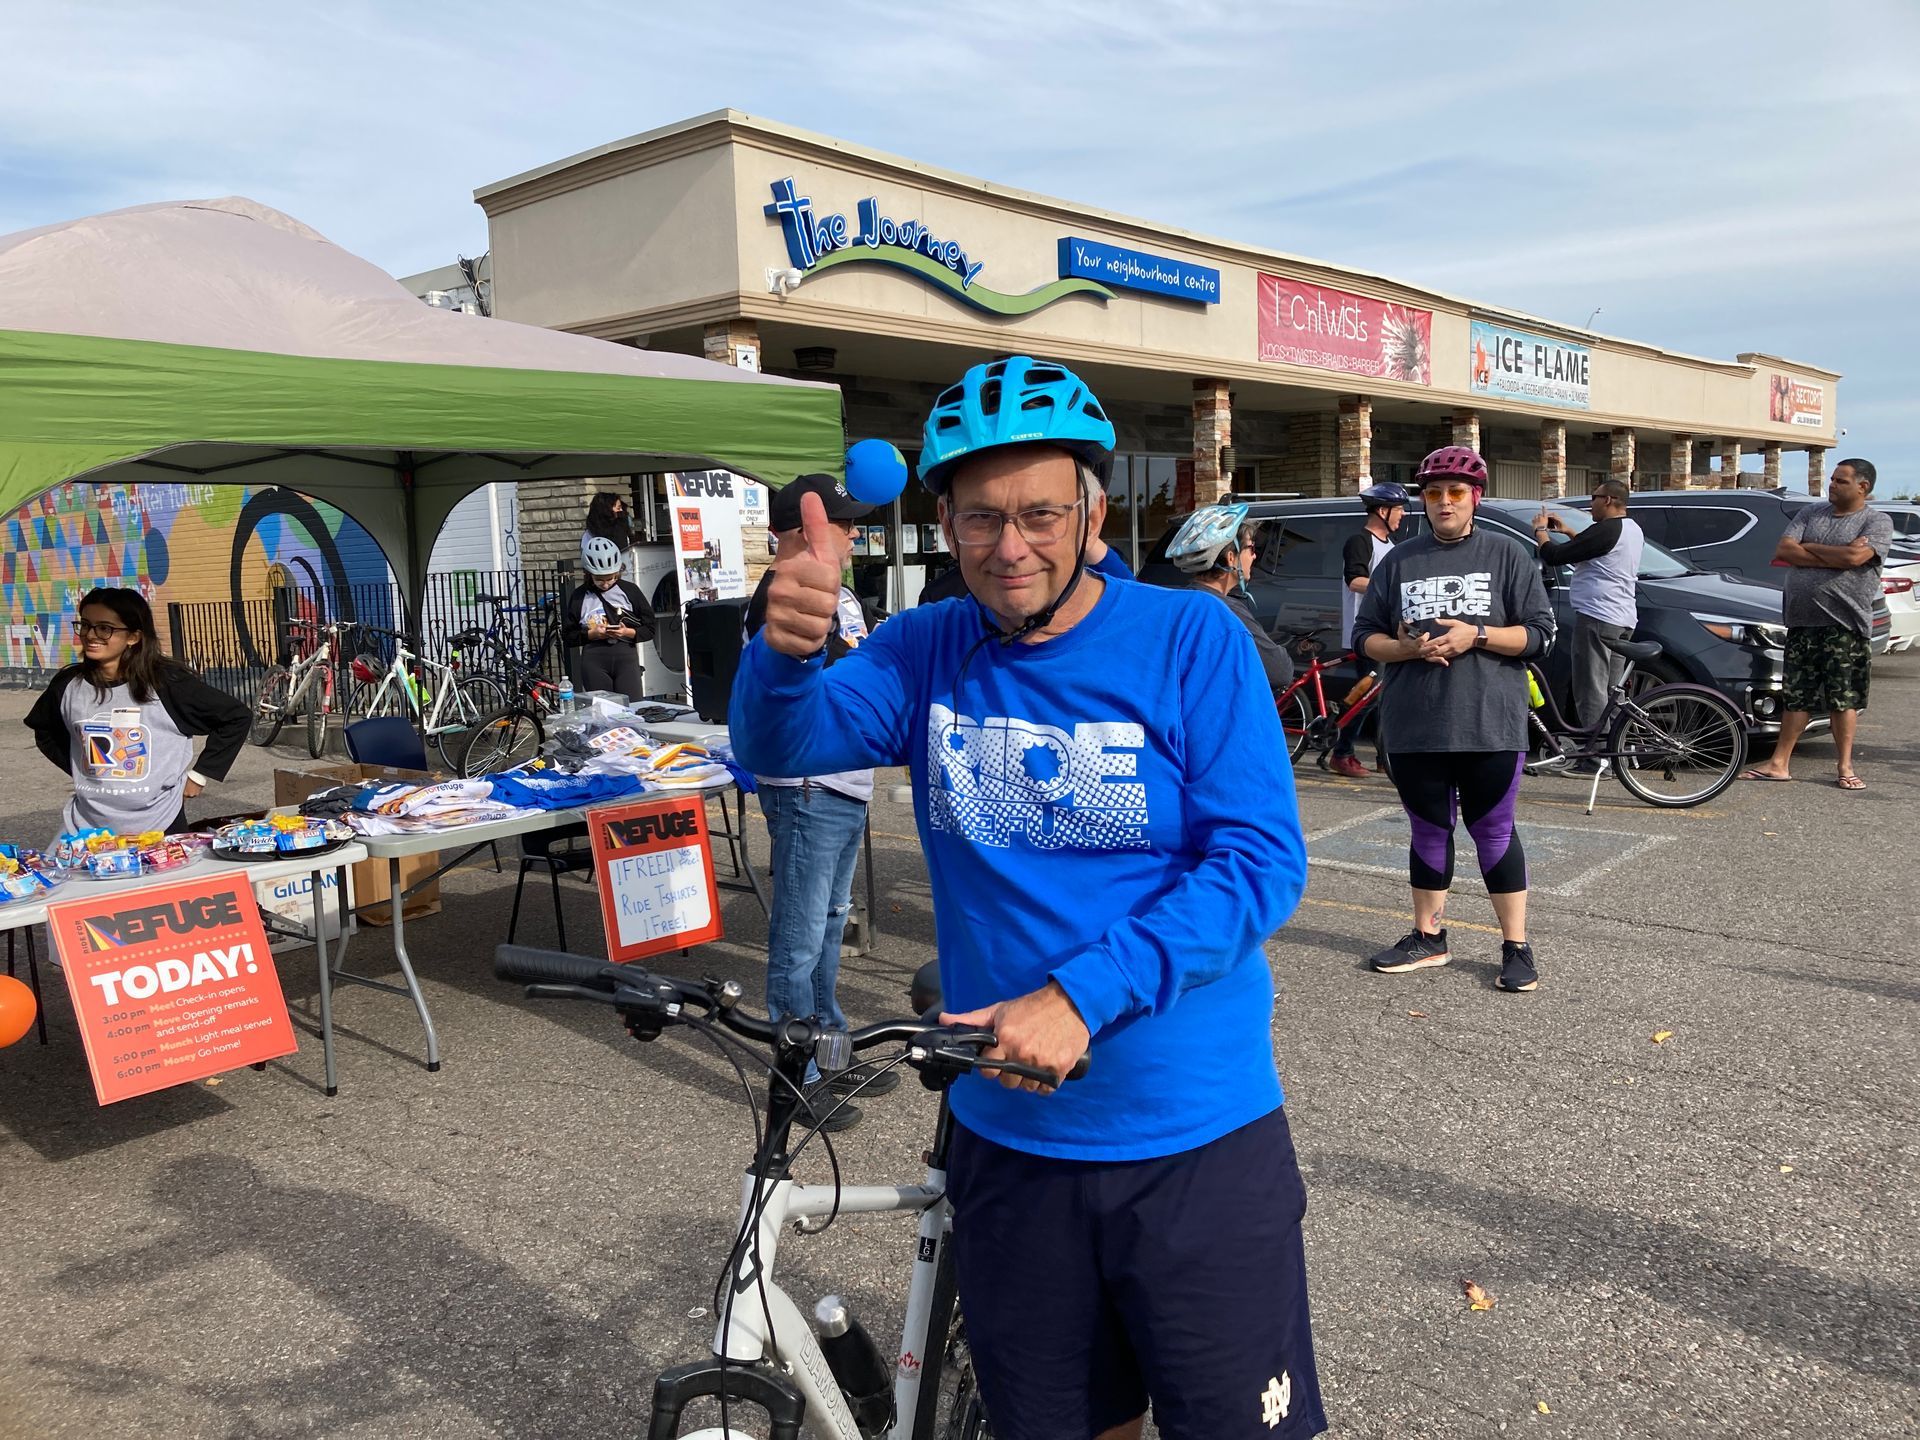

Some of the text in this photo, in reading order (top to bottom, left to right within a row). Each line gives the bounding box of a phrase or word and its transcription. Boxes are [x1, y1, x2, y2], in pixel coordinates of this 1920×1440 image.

[864, 195, 983, 290] Journey
[1076, 246, 1216, 293] Your neighbourhood centre
[1476, 370, 1489, 384] ICE
[1496, 335, 1589, 386] ICE FLAME
[1400, 572, 1491, 609] RIDE
[1407, 598, 1491, 622] REFUGE
[607, 809, 698, 849] REFUGE
[84, 891, 243, 952] REFUGE
[622, 894, 651, 916] RIDE
[90, 943, 258, 1006] TODAY!
[102, 985, 246, 1024] 3:00 pm Meet Check-in opens
[107, 997, 259, 1039] 4:00 pm Move Opening remarks
[113, 1016, 273, 1065] 5:00 pm Munch Light meal served
[156, 1015, 217, 1038] and send-off
[117, 1039, 241, 1079] 6:00 pm Mosey Go home!
